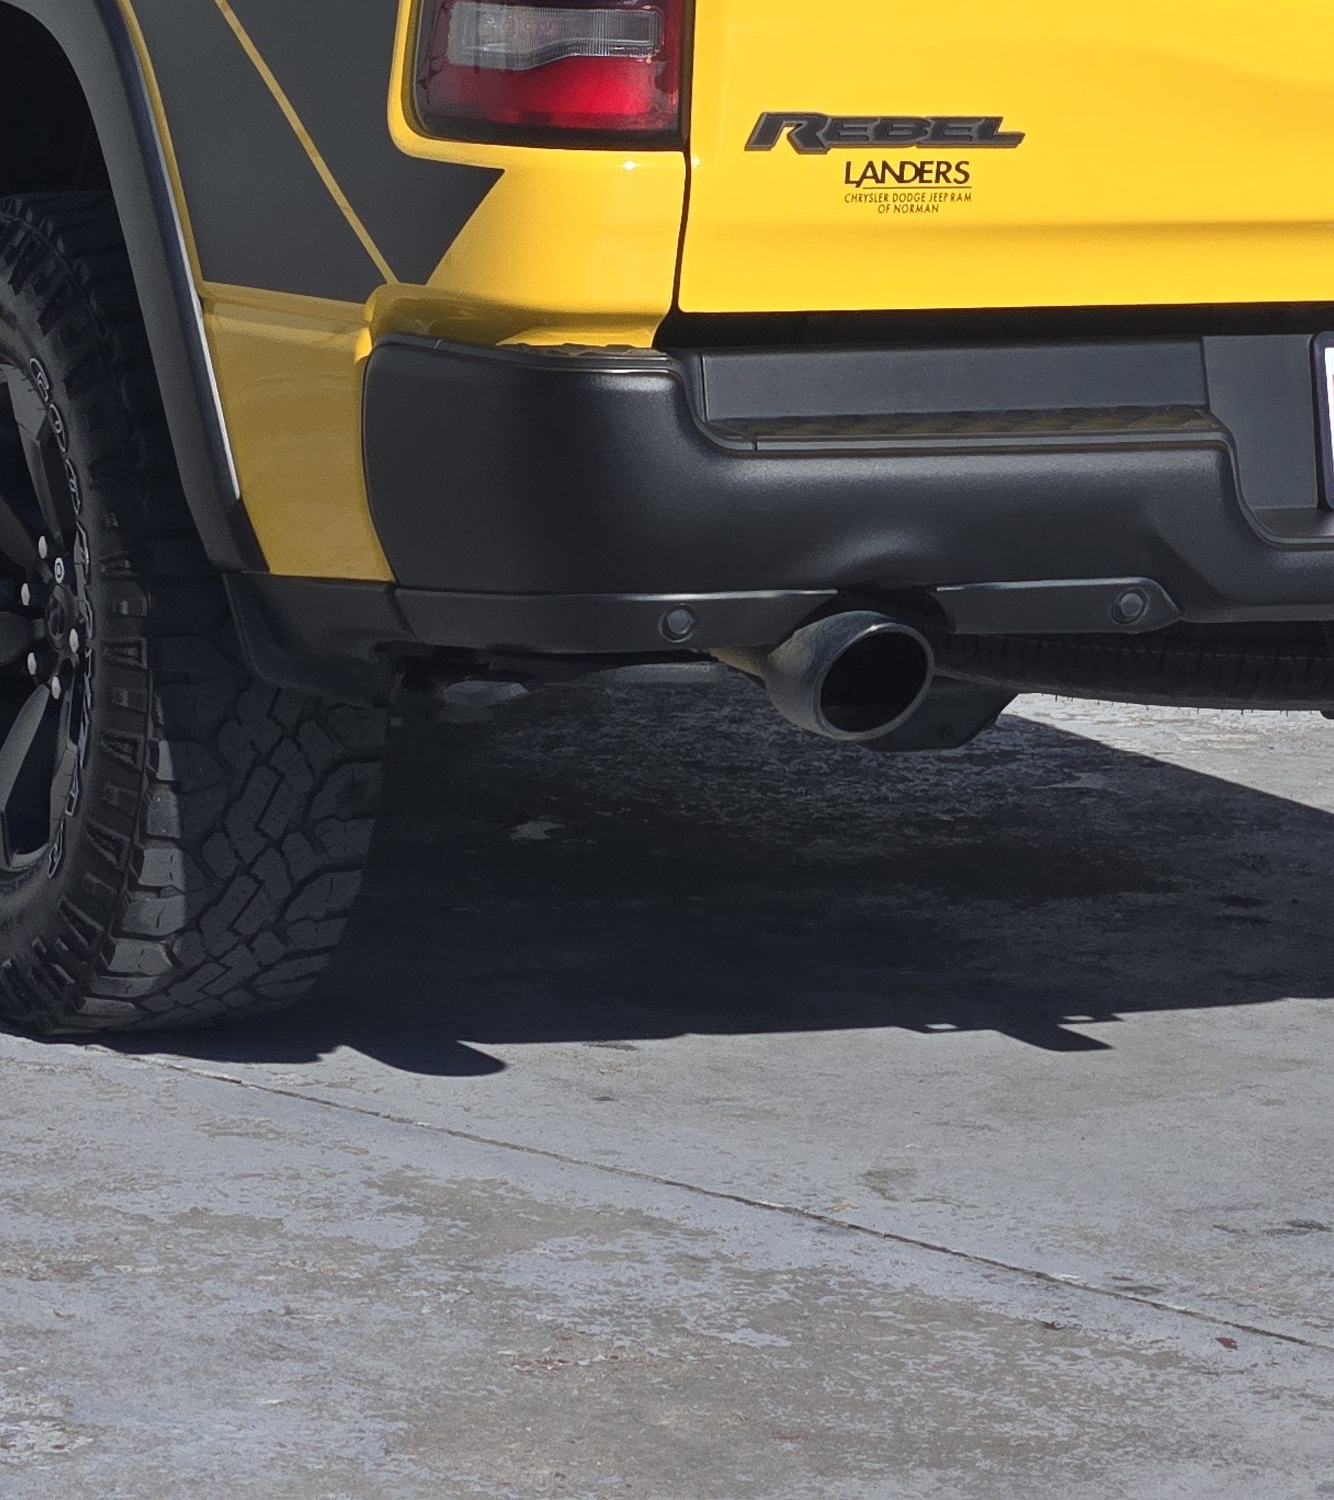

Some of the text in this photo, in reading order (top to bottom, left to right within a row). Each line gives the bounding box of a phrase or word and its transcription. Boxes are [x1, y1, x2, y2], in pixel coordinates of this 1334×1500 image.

[744, 111, 1026, 155] REBEL
[844, 160, 970, 188] LANDERS
[844, 192, 889, 203] CHRYSLER
[892, 192, 926, 203] DODGE
[950, 192, 972, 202] RAM
[878, 203, 939, 214] OF NORMAN
